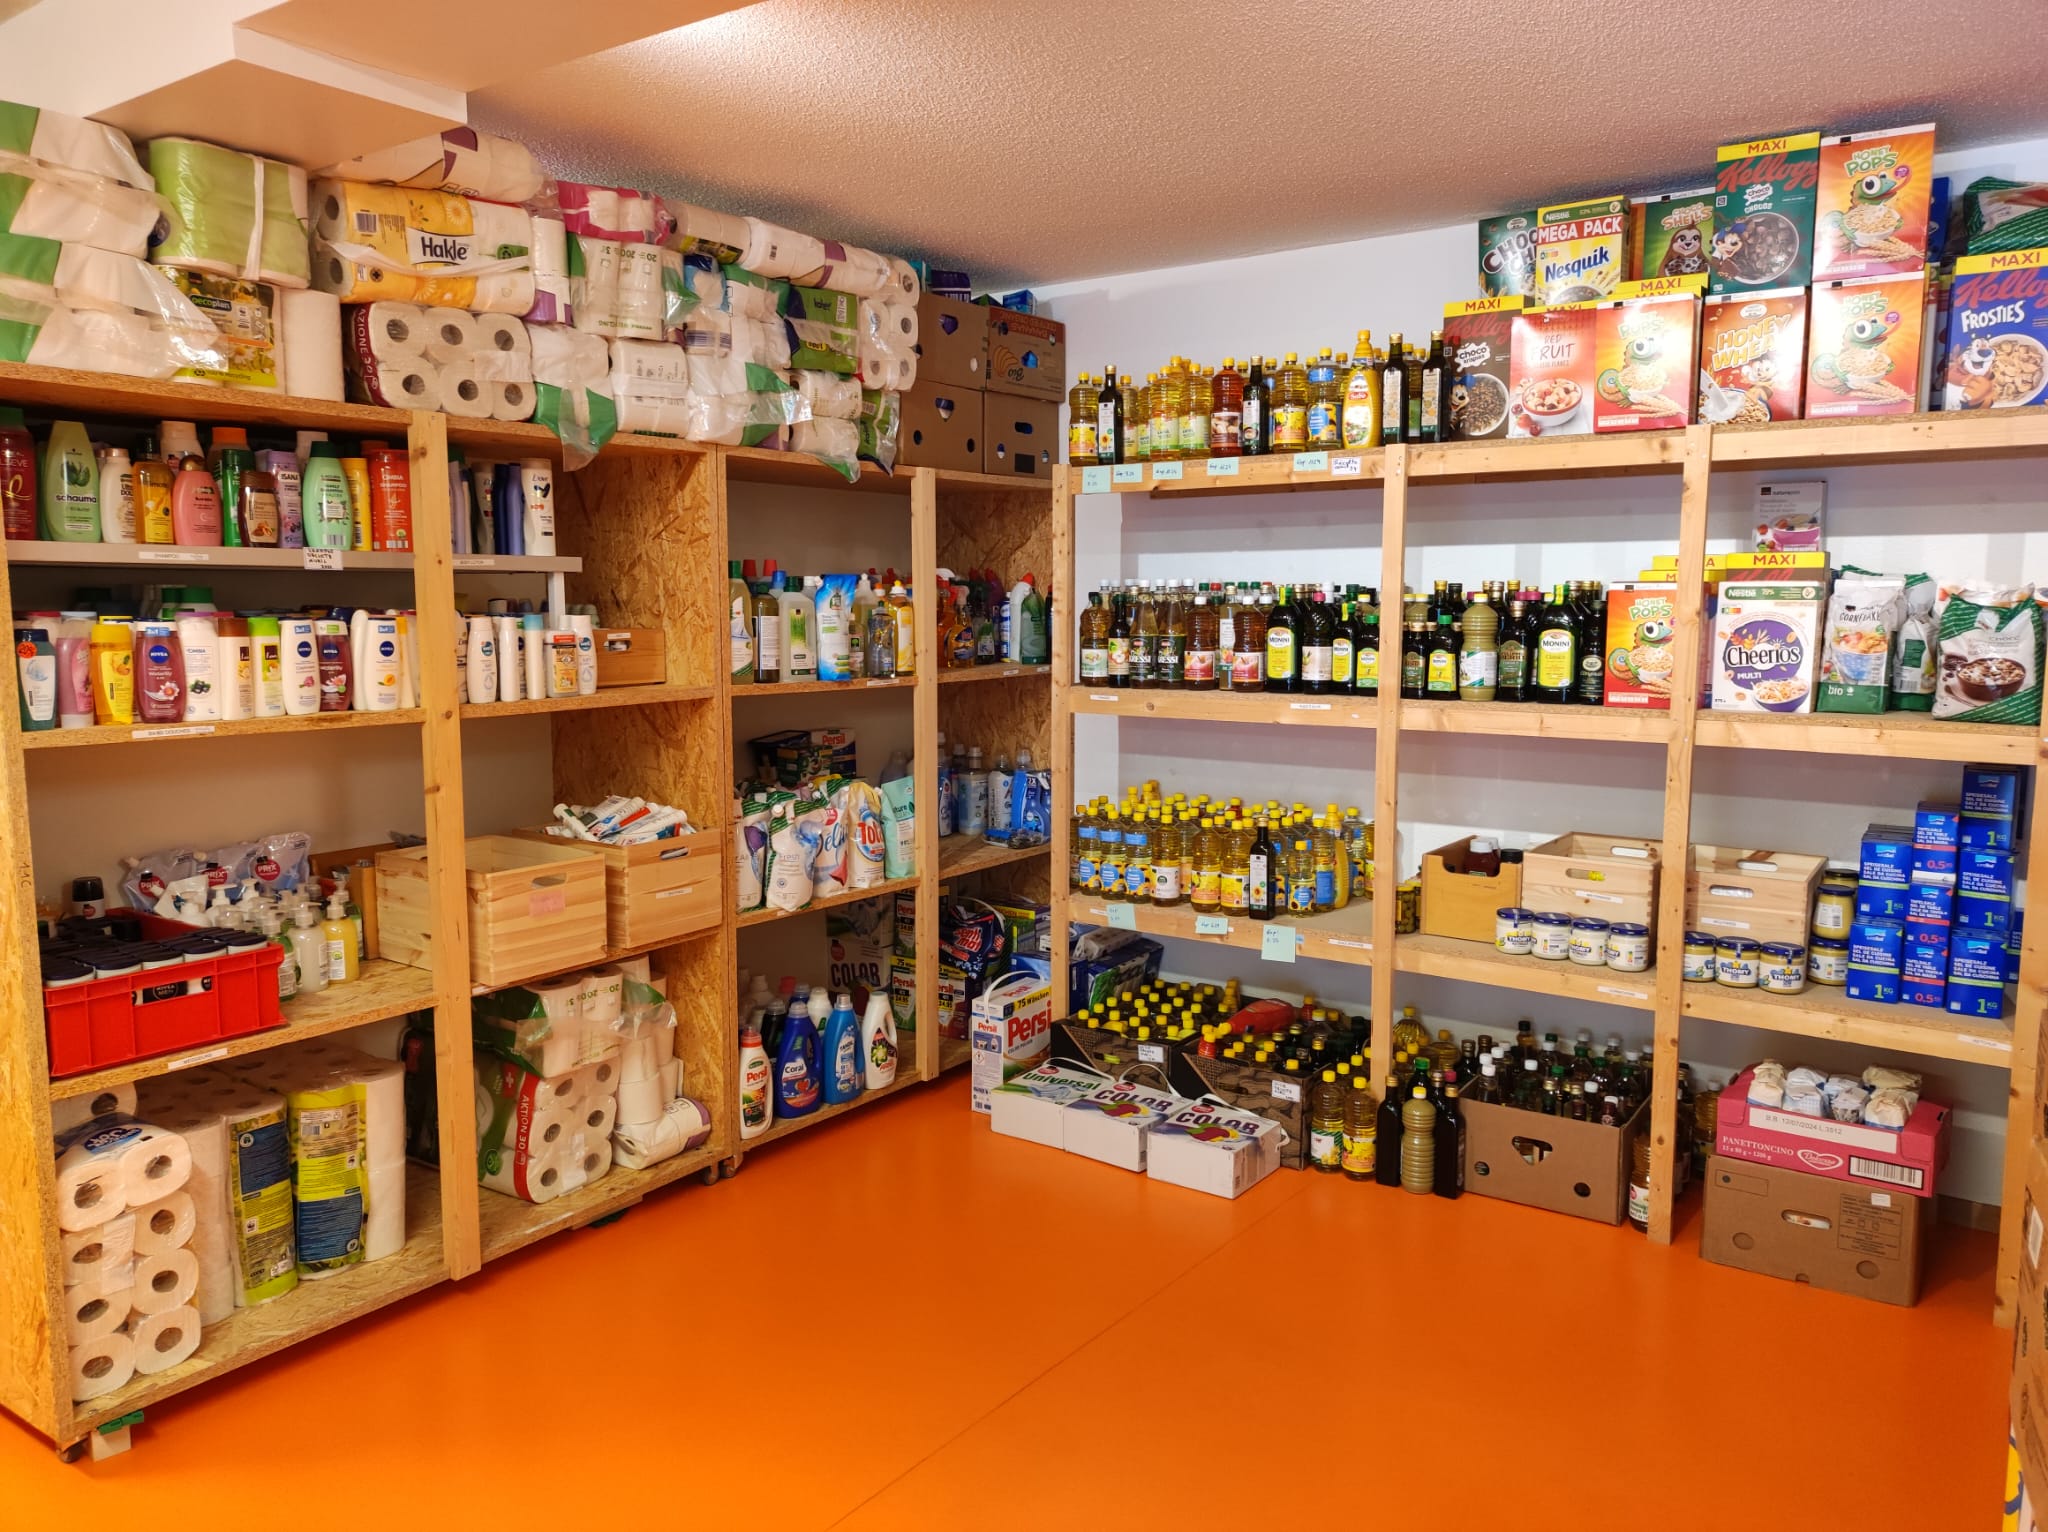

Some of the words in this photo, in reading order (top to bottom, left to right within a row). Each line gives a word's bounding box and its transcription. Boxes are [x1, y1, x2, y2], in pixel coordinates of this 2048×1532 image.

[1748, 139, 1786, 154] MAXI
[1845, 152, 1899, 176] POPS
[1748, 185, 1770, 197] choco
[1661, 206, 1714, 230] SHELLS
[1538, 223, 1579, 244] MEGA
[1584, 215, 1623, 234] PACK
[421, 236, 468, 261] Hakle
[1545, 246, 1610, 283] Nesquik
[1991, 252, 2041, 267] MAXI
[1640, 277, 1682, 290] MAXI
[1464, 298, 1502, 312] MAXI
[1961, 301, 2026, 333] FROSTIES
[355, 308, 370, 358] AZIONE
[1544, 334, 1562, 344] RED
[1717, 314, 1791, 352] HONEY
[1459, 346, 1488, 360] choco
[1713, 337, 1775, 371] WHEA
[1007, 367, 1025, 381] Bio
[56, 494, 97, 503] schauma
[1753, 554, 1796, 566] MAXI
[1629, 604, 1673, 620] POPS
[1542, 640, 1571, 648] MONINI
[1727, 646, 1801, 667] Cheerios
[1737, 671, 1762, 680] MULTI
[1828, 686, 1844, 696] bio
[822, 734, 846, 745] Persil
[1986, 831, 1997, 846] 1
[1885, 900, 1894, 914] 1
[1984, 912, 1994, 927] 1
[831, 963, 881, 988] COLOR
[1721, 967, 1750, 975] THOMY
[938, 982, 954, 992] ersil
[1874, 984, 1884, 999] 1
[1017, 998, 1026, 1008] 75
[1977, 999, 1987, 1014] 1
[978, 1022, 998, 1033] Persil
[1008, 1000, 1051, 1048] Persi
[746, 1066, 768, 1083] Persil
[784, 1063, 804, 1074] Coral
[1023, 1073, 1101, 1090] Universal
[1094, 1089, 1174, 1113] COLOR
[519, 1095, 530, 1131] AKTION
[1175, 1112, 1260, 1136] COLOR
[1723, 1135, 1794, 1156] PANETTONCINO
